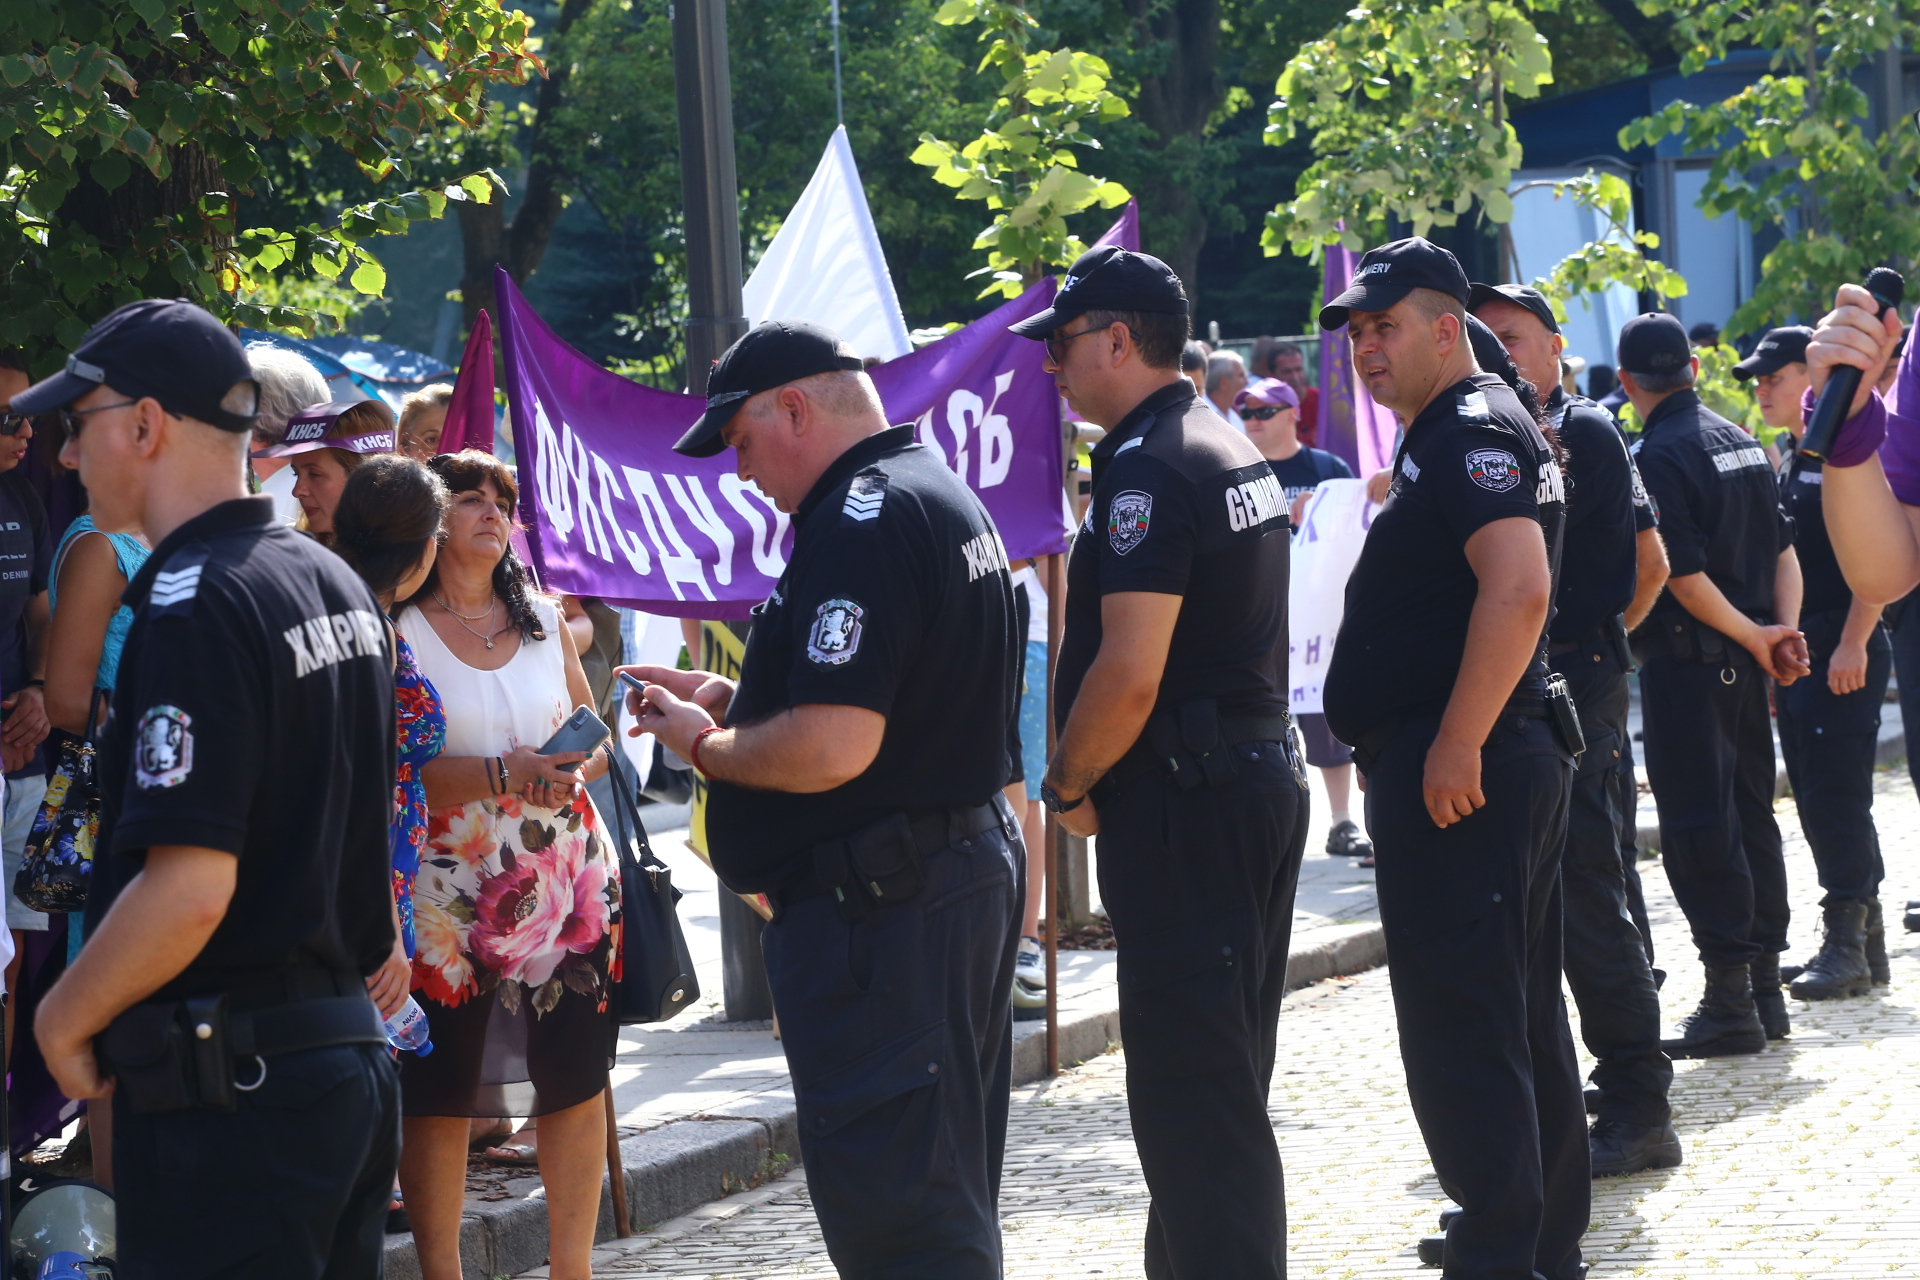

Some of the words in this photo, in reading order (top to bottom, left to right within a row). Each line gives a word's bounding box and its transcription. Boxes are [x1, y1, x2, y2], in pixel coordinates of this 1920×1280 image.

[286, 423, 327, 440] КНСБ
[353, 434, 393, 451] КНСБ
[2, 570, 29, 580] DENIM
